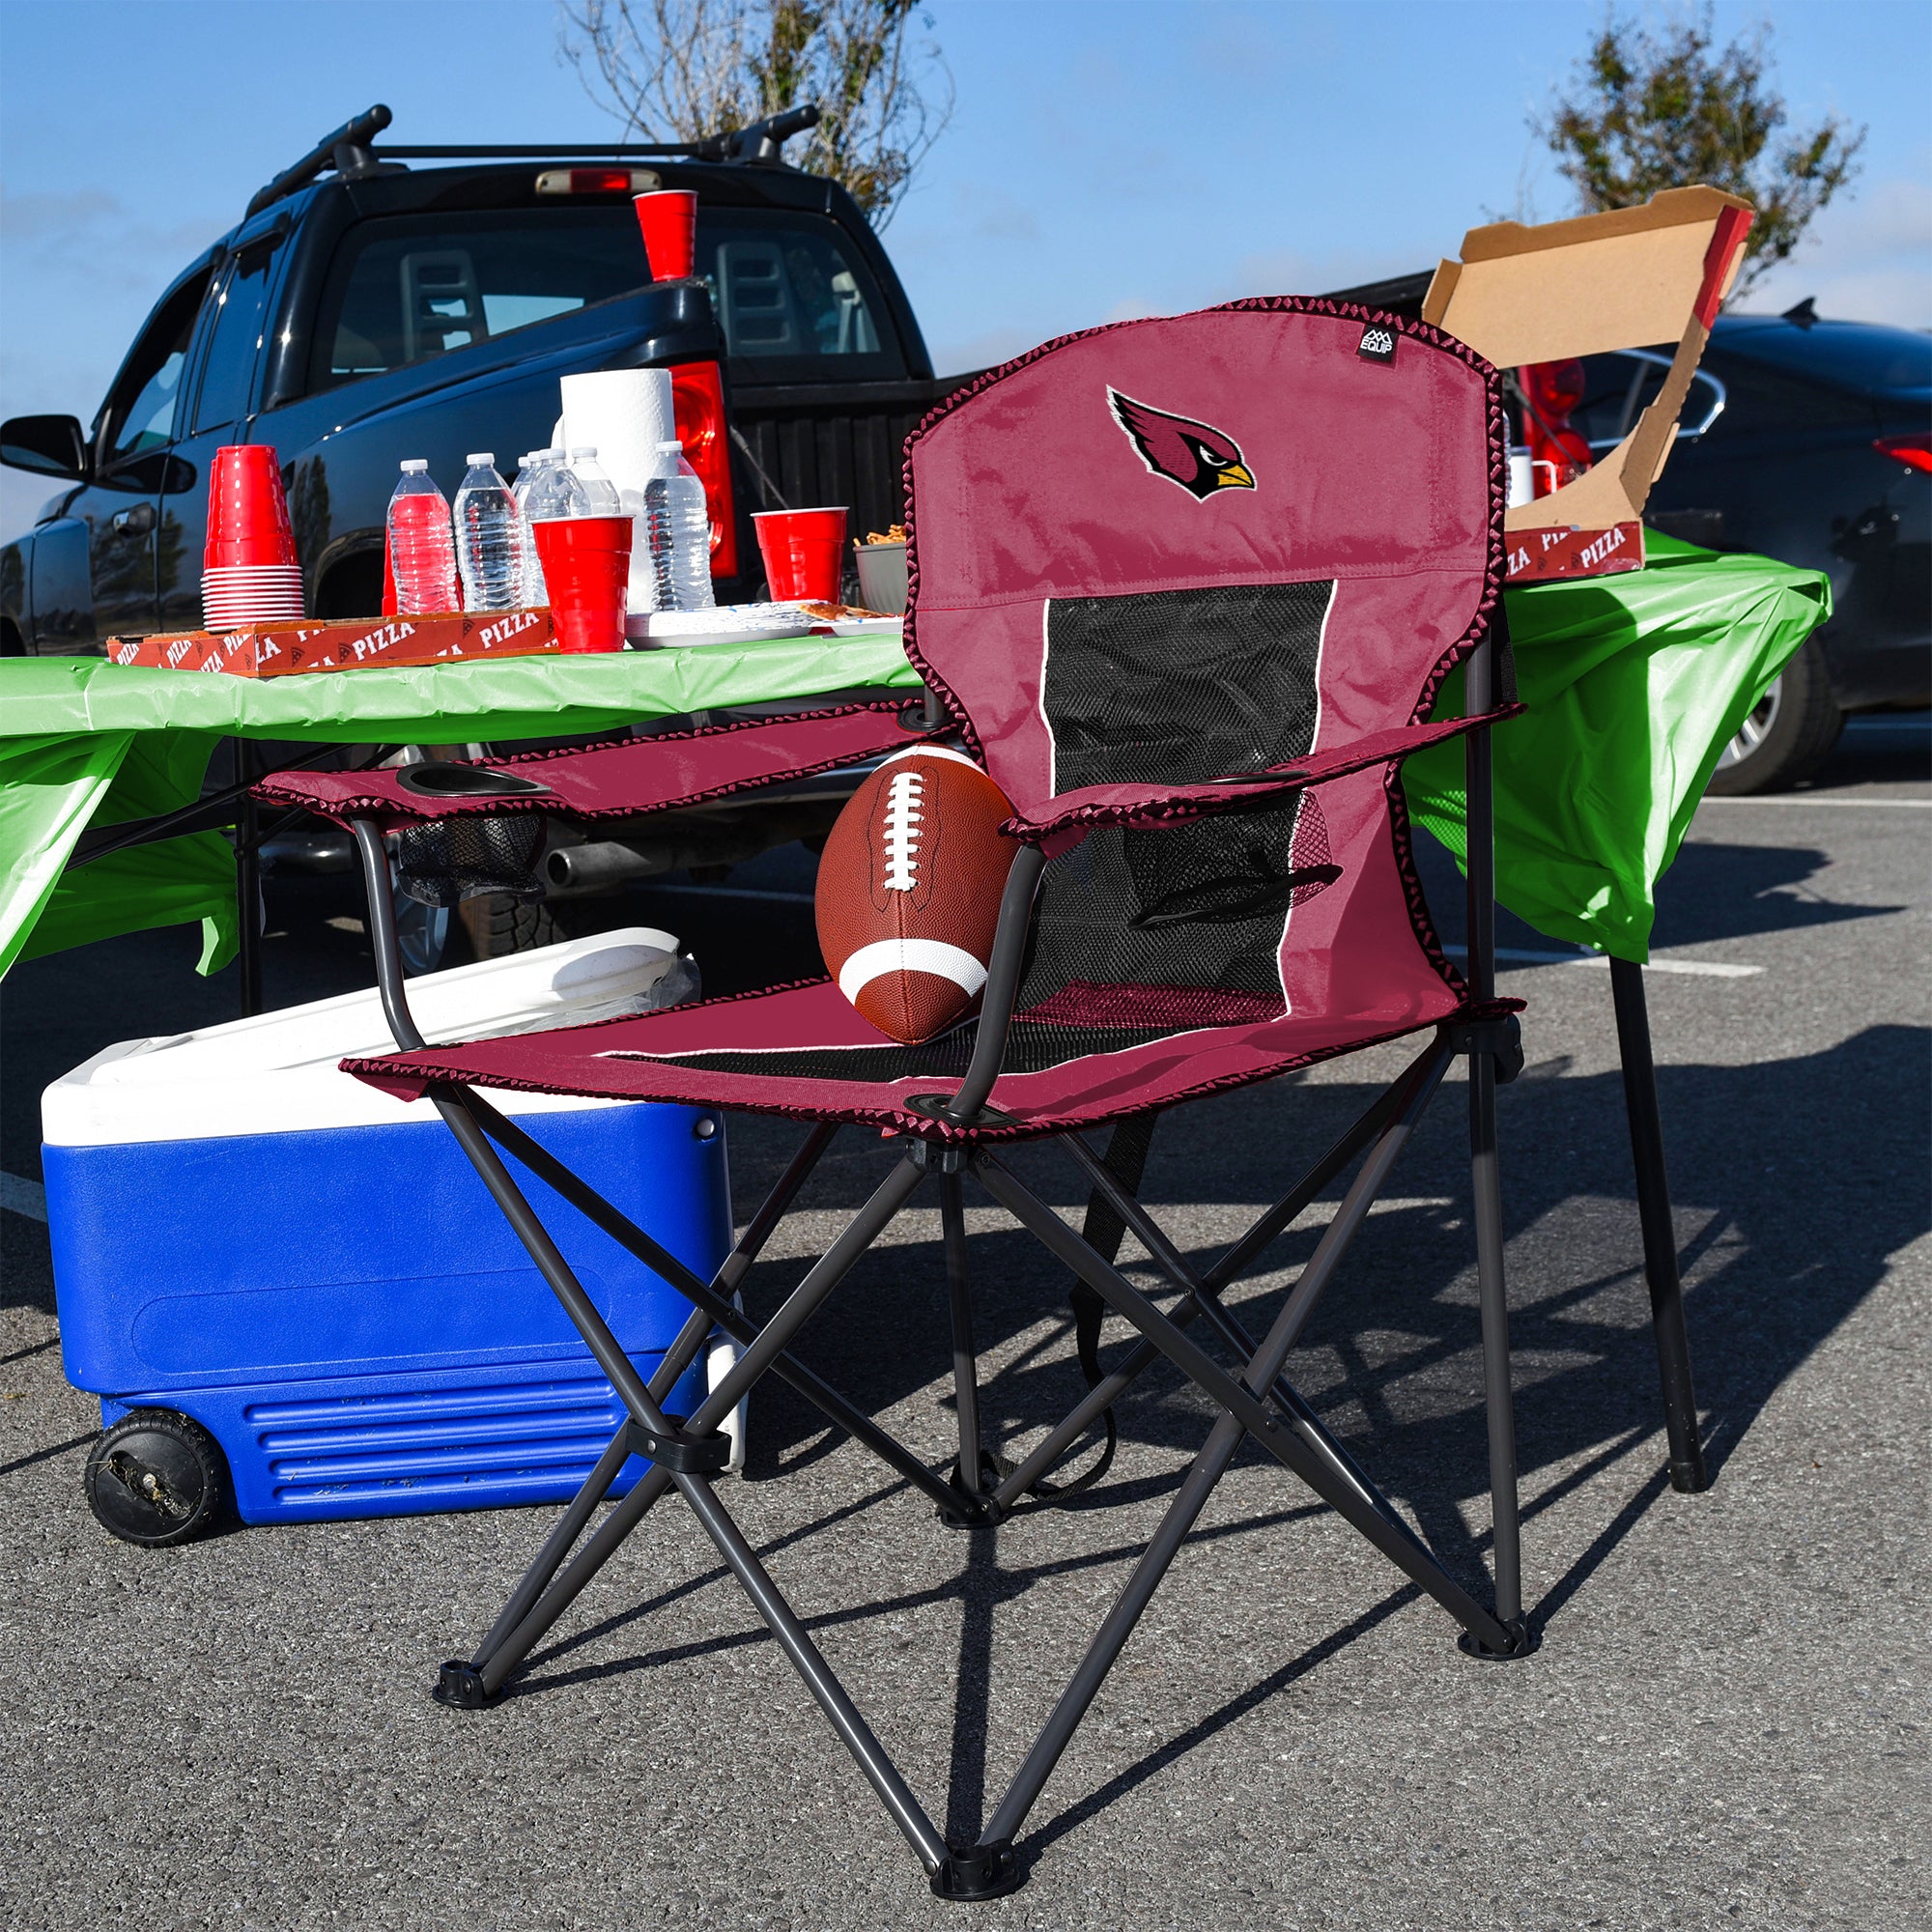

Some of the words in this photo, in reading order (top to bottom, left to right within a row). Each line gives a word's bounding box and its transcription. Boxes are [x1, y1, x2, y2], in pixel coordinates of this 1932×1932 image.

[1360, 338, 1393, 354] EQUIP
[1580, 527, 1627, 569] PIZZA
[352, 623, 416, 661] PIZZA
[479, 612, 540, 649] PIZZA
[166, 639, 193, 669] PIZZA
